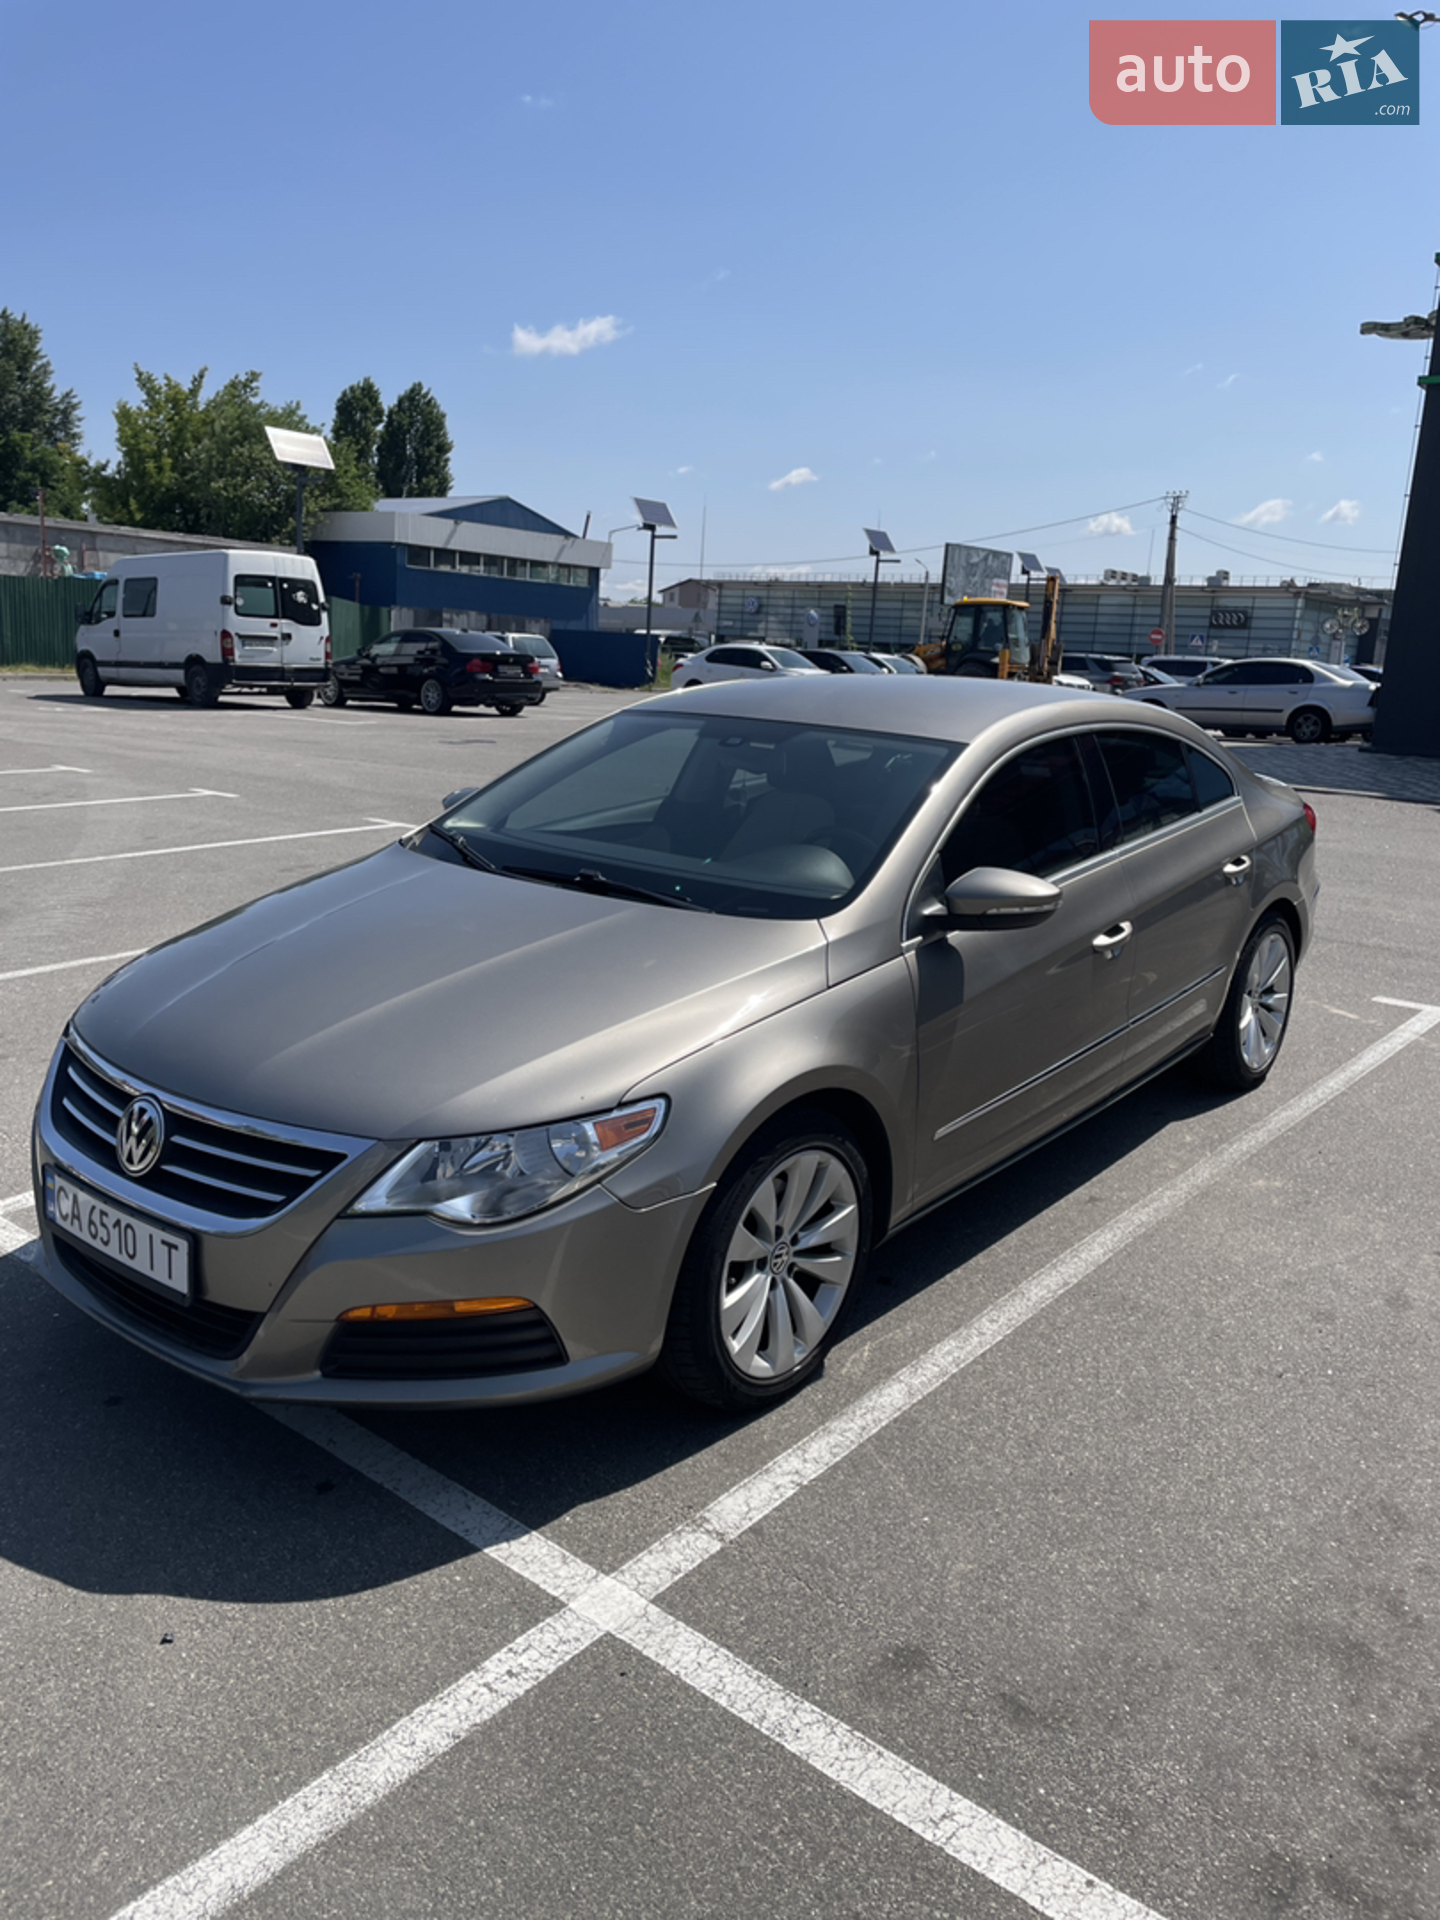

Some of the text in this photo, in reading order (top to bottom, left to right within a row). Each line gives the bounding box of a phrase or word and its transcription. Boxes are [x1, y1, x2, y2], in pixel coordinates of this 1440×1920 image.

[56, 1187, 179, 1280] CA 6510 IT
